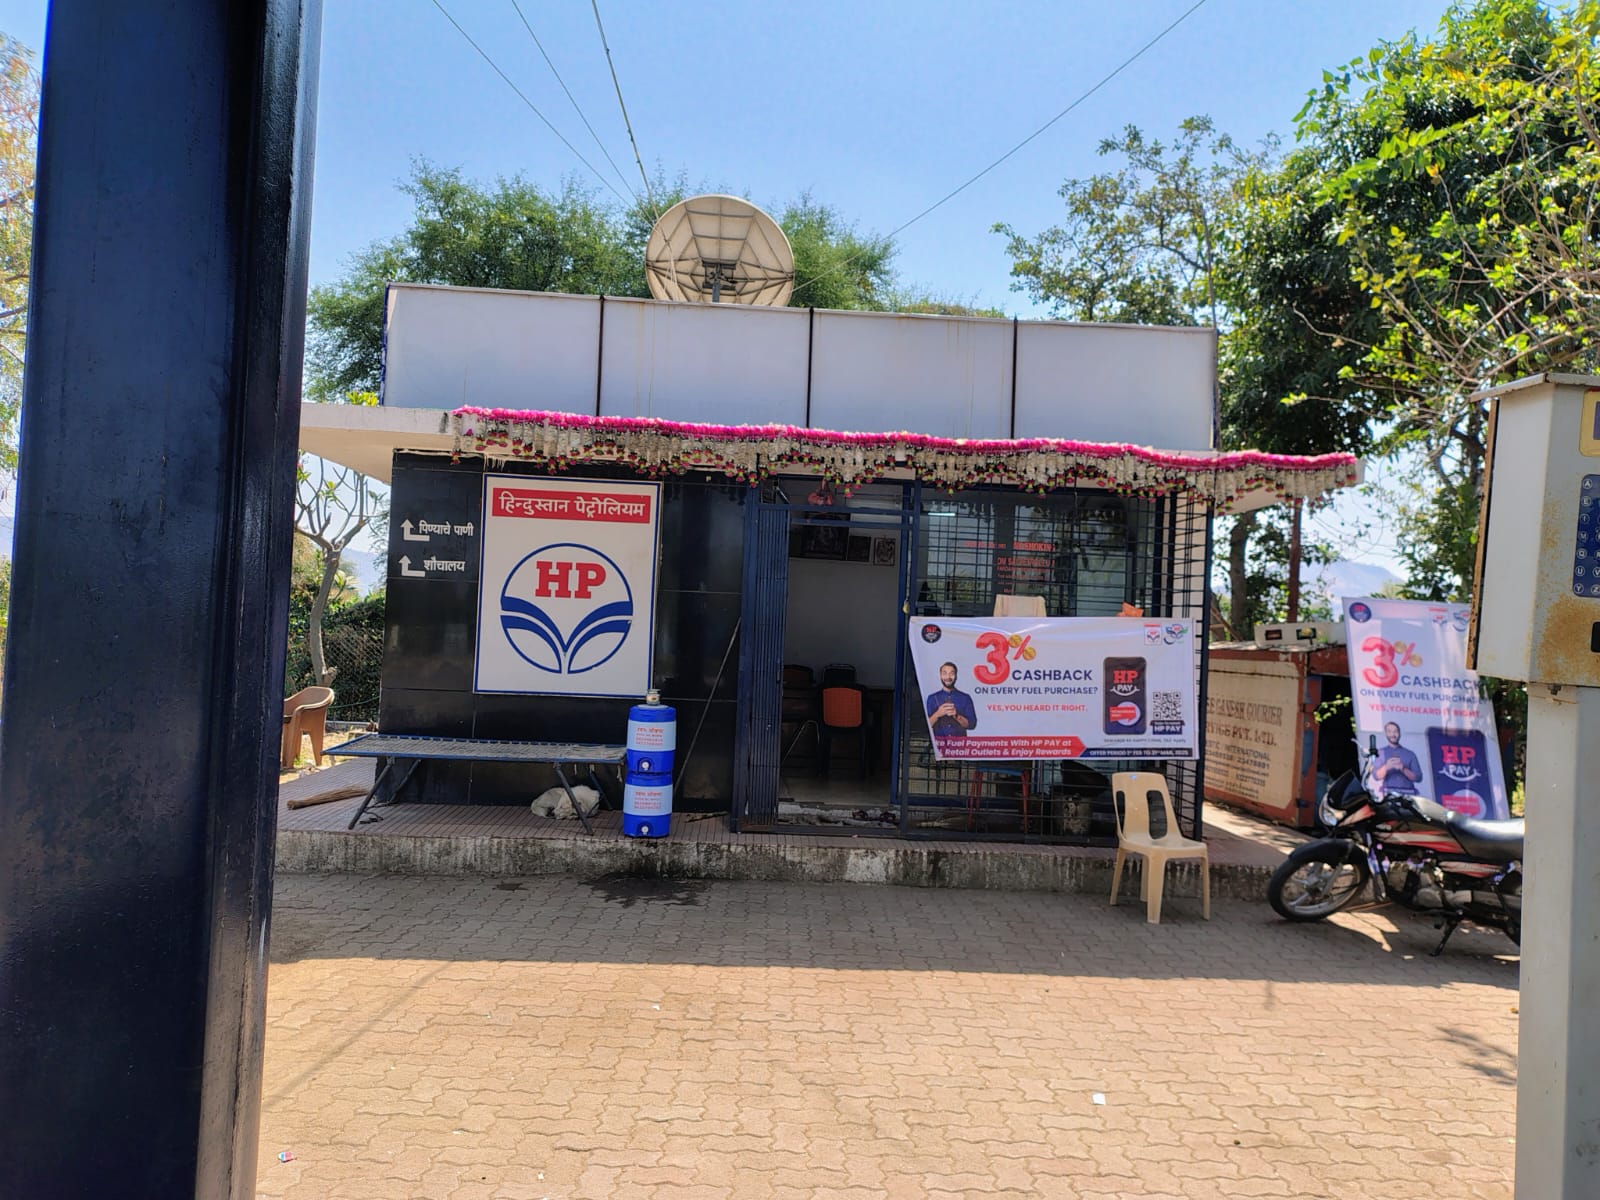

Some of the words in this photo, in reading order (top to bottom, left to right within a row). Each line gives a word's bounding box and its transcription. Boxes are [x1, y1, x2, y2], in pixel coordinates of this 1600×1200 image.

[499, 491, 570, 515] हिन्दुस्तान
[574, 496, 646, 518] पेट्रोलियम
[418, 520, 451, 536] पिण्याचे
[453, 522, 474, 537] पाणी
[424, 555, 466, 572] शौचालय
[535, 561, 606, 599] HP
[1011, 669, 1093, 681] CASHBACK
[1113, 669, 1138, 684] HP
[1401, 674, 1482, 691] CASHBACK
[974, 686, 989, 695] ON
[990, 686, 1020, 695] EVERY
[1021, 686, 1042, 695] FUEL
[1044, 686, 1099, 695] PURCHASE?
[1360, 688, 1376, 698] ON
[1377, 690, 1407, 699] EVERY
[1408, 692, 1431, 701] FUEL
[1023, 704, 1051, 712] HEARD
[1052, 704, 1060, 712] IT
[1061, 704, 1089, 712] RIGHT.
[1410, 705, 1441, 716] HEARD
[966, 740, 1009, 749] Payments
[945, 748, 970, 756] Retail
[971, 748, 1001, 756] Outlets
[1011, 748, 1034, 757] Enjoy
[1035, 748, 1072, 756] Rewards
[1441, 745, 1476, 764] HP
[1448, 764, 1471, 776] PAY
